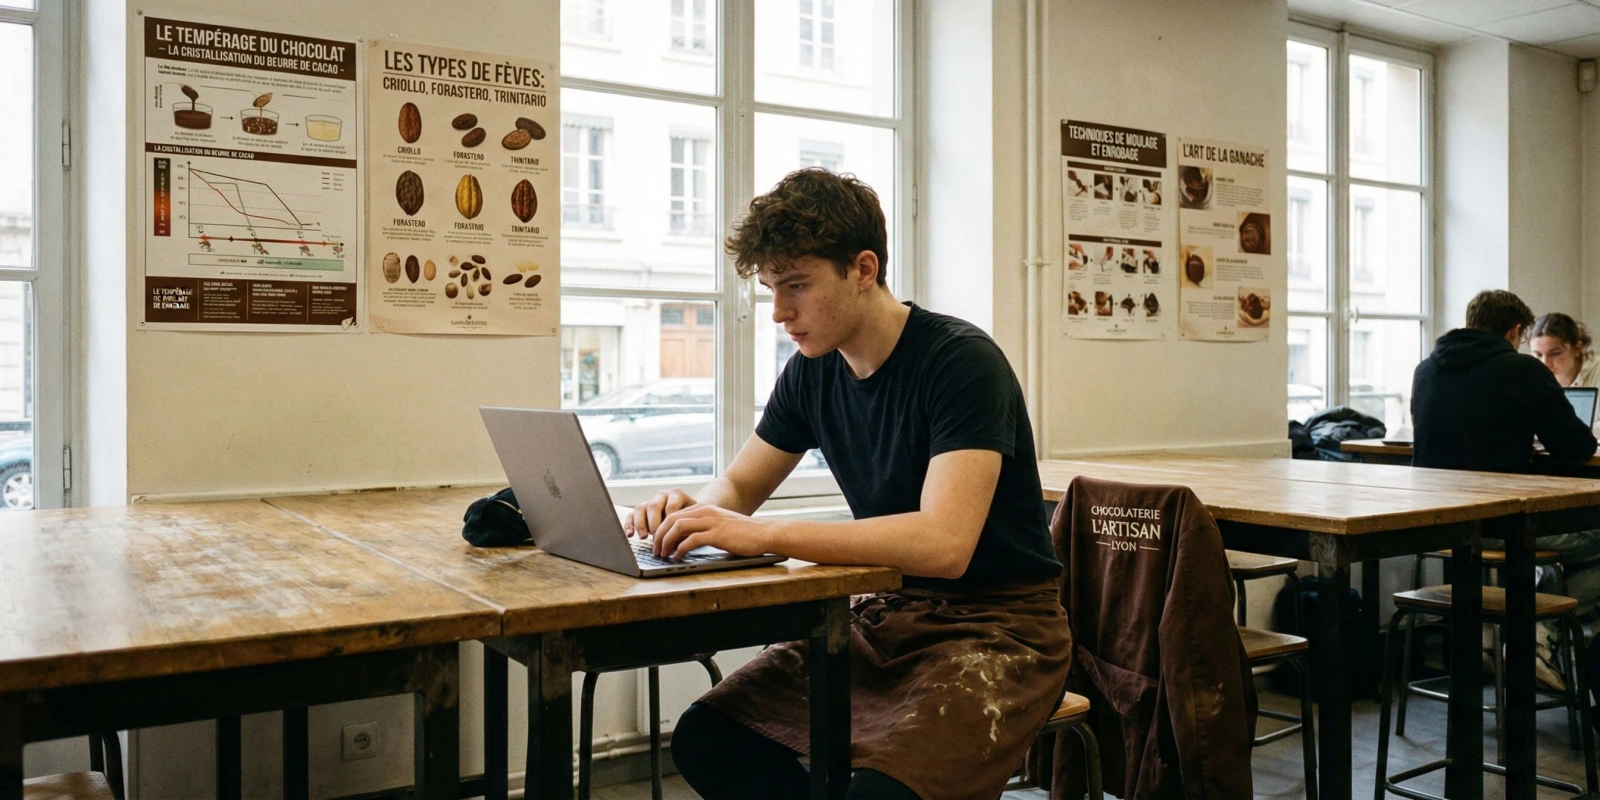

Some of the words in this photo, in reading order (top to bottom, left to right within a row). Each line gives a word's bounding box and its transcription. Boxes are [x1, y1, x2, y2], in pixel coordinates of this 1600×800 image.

[156, 24, 172, 42] LE
[176, 26, 257, 51] TEMPÉRAGE
[260, 37, 278, 54] DU
[281, 39, 345, 62] CHOCOLAT
[168, 45, 179, 56] LA
[181, 45, 252, 65] CRISTALLISATION
[254, 54, 265, 66] DU
[267, 56, 299, 70] BEURRE
[300, 61, 310, 71] DE
[312, 61, 338, 74] CACAO
[384, 50, 413, 72] LES
[418, 54, 467, 79] TYPES
[471, 61, 491, 82] DE
[495, 61, 545, 88] FÈVES:
[383, 76, 428, 95] CRIOLLO,
[431, 82, 491, 103] FORASTERO,
[494, 90, 547, 107] TRINITARIO
[1069, 125, 1114, 145] TECHNIQUES
[1115, 131, 1124, 145] DE
[1126, 132, 1158, 150] MOULAGE
[1091, 143, 1101, 156] ET
[1102, 144, 1139, 161] ENROBAGE
[1183, 143, 1204, 159] L'ART
[1206, 146, 1216, 161] DE
[1218, 147, 1228, 163] LA
[1229, 149, 1265, 168] GANACHE
[393, 218, 426, 228] FORASTERO
[1091, 505, 1160, 520] CHOCOLATERIE
[1091, 519, 1161, 540] L'ARTISAN
[1111, 540, 1137, 552] LYON
